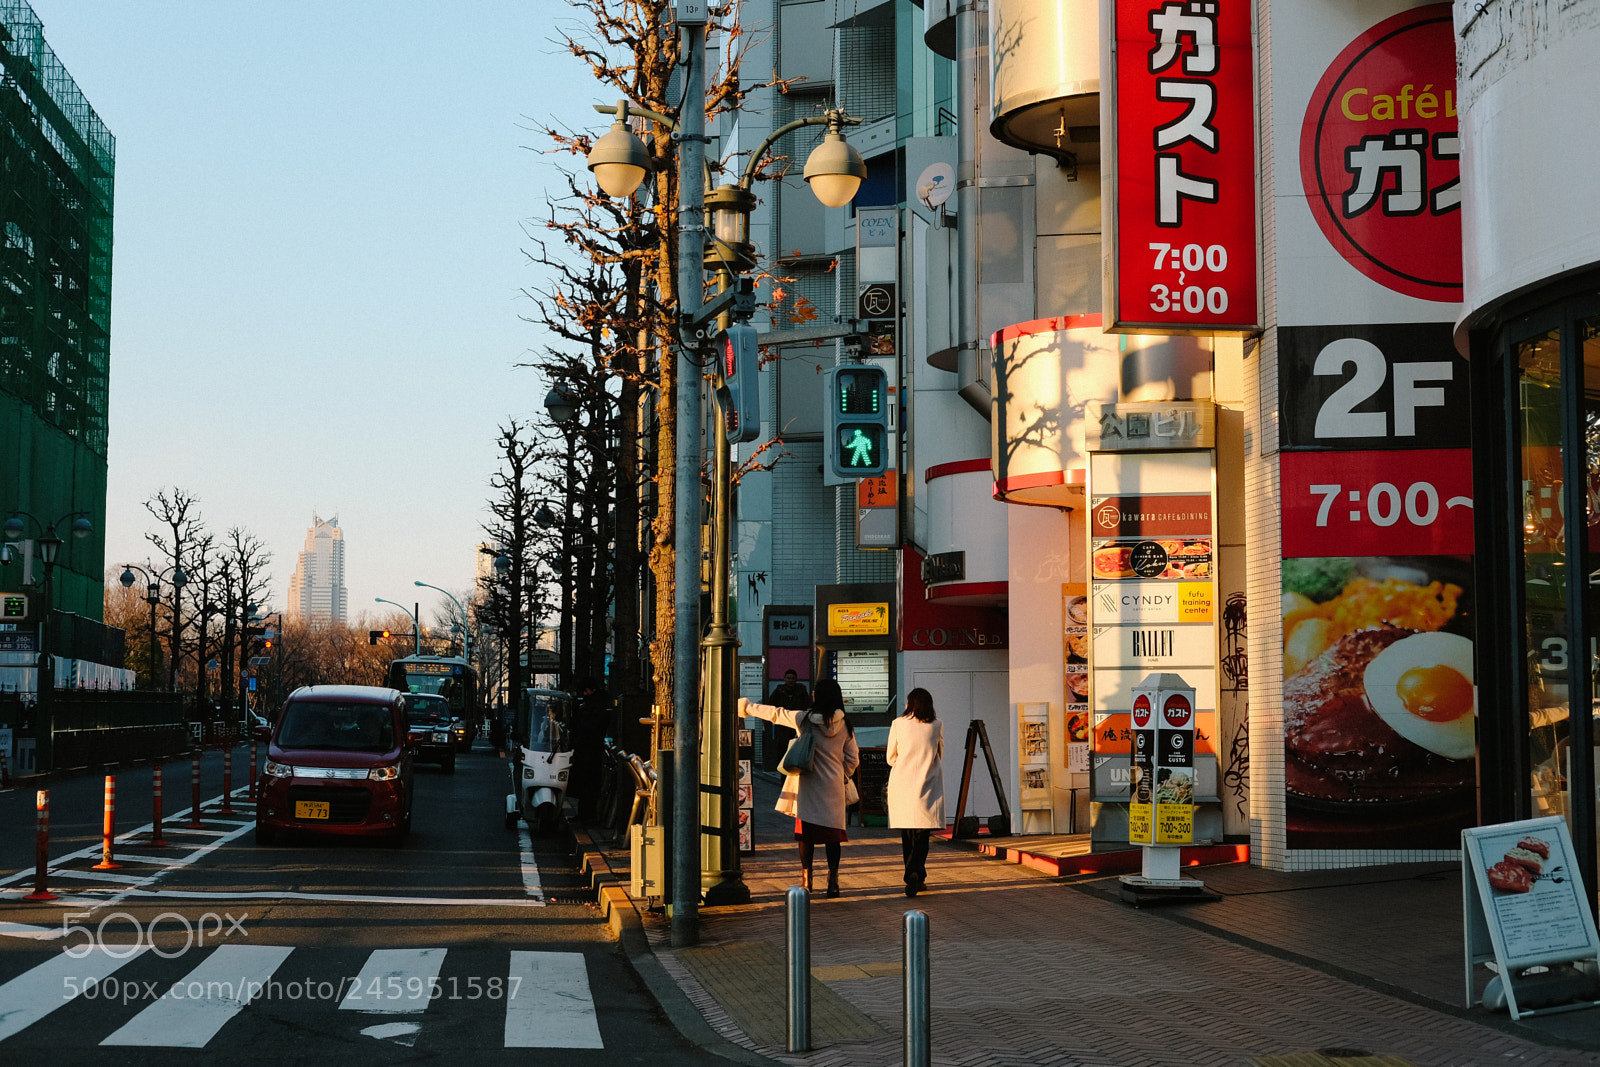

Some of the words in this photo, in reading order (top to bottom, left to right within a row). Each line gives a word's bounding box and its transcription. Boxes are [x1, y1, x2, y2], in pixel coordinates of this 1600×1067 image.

[1148, 0, 1220, 228] ガスト
[861, 216, 894, 228] COEN
[1149, 242, 1228, 273] 7:00
[1149, 284, 1229, 315] 3:00
[1313, 337, 1454, 439] 2F
[1098, 408, 1203, 441] 公園ビル
[1122, 512, 1156, 522] kawara
[1188, 590, 1205, 598] fufu
[1121, 595, 1172, 606] CYNDY
[1182, 598, 1211, 607] training
[1184, 606, 1209, 614] center
[1132, 630, 1175, 657] BALLET
[1134, 708, 1150, 718] ガスト
[1167, 708, 1189, 718] ガスト
